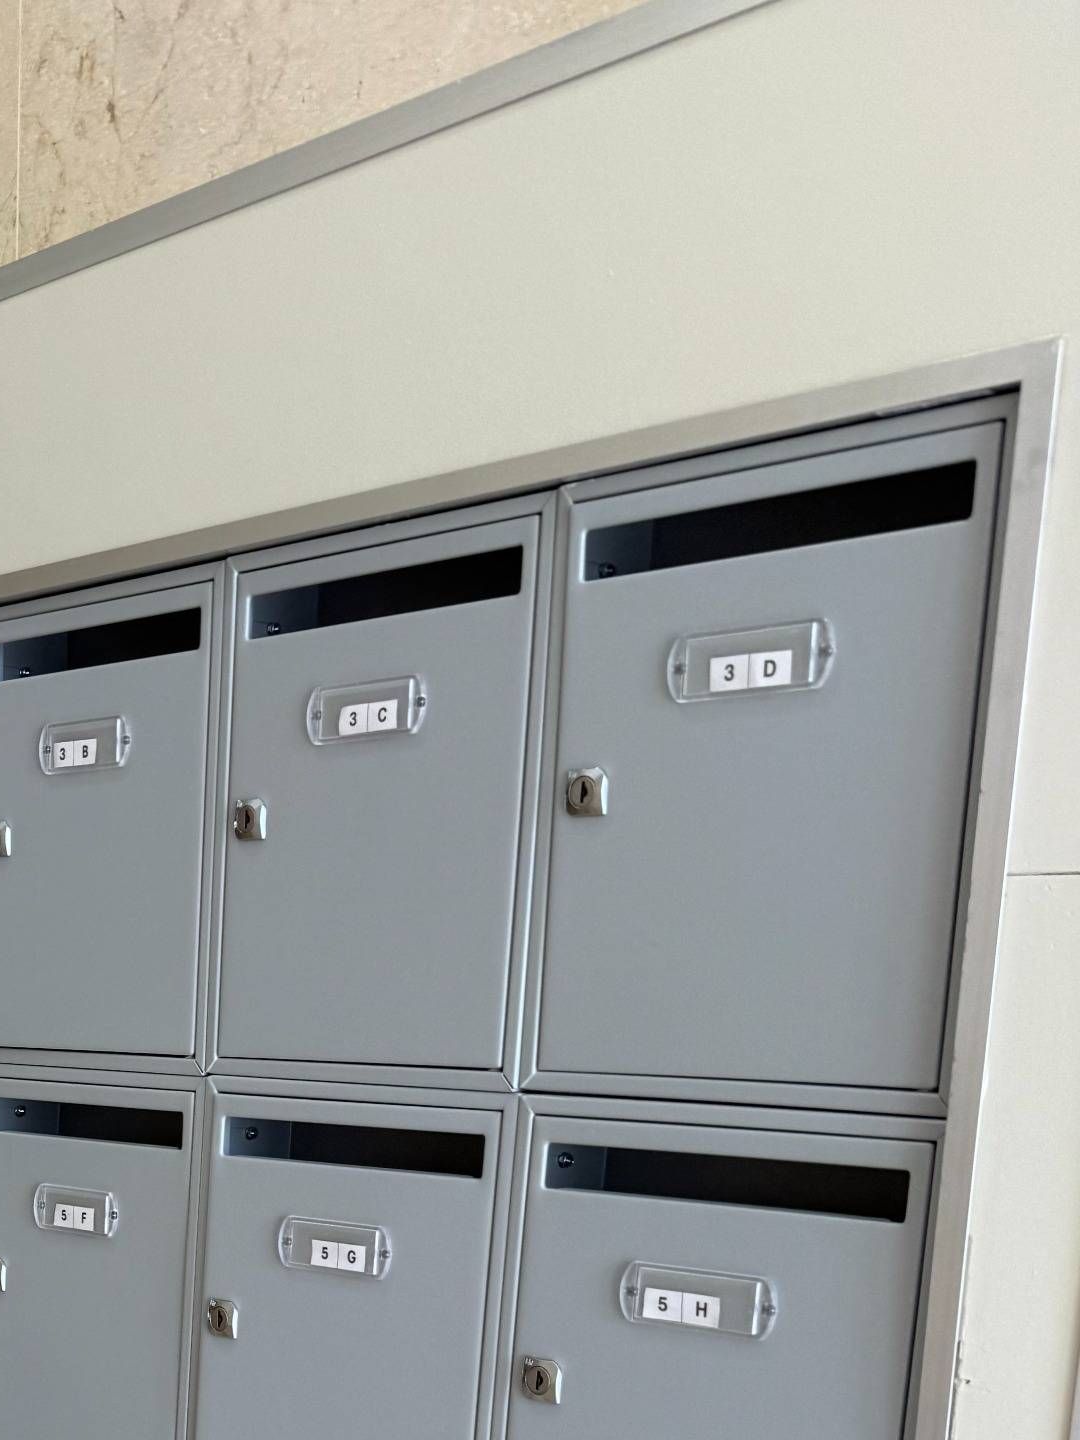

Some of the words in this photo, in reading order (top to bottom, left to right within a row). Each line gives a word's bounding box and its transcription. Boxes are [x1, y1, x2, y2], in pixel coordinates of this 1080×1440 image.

[724, 664, 734, 682] 3
[763, 660, 776, 678] D
[350, 712, 357, 726] 3
[378, 707, 387, 722] C
[59, 748, 66, 760] 3
[82, 745, 88, 758] B
[61, 1210, 67, 1221] 5
[82, 1212, 86, 1224] F
[321, 1246, 329, 1260] 5
[348, 1250, 356, 1264] G
[658, 1296, 668, 1312] 5
[696, 1301, 708, 1318] H
